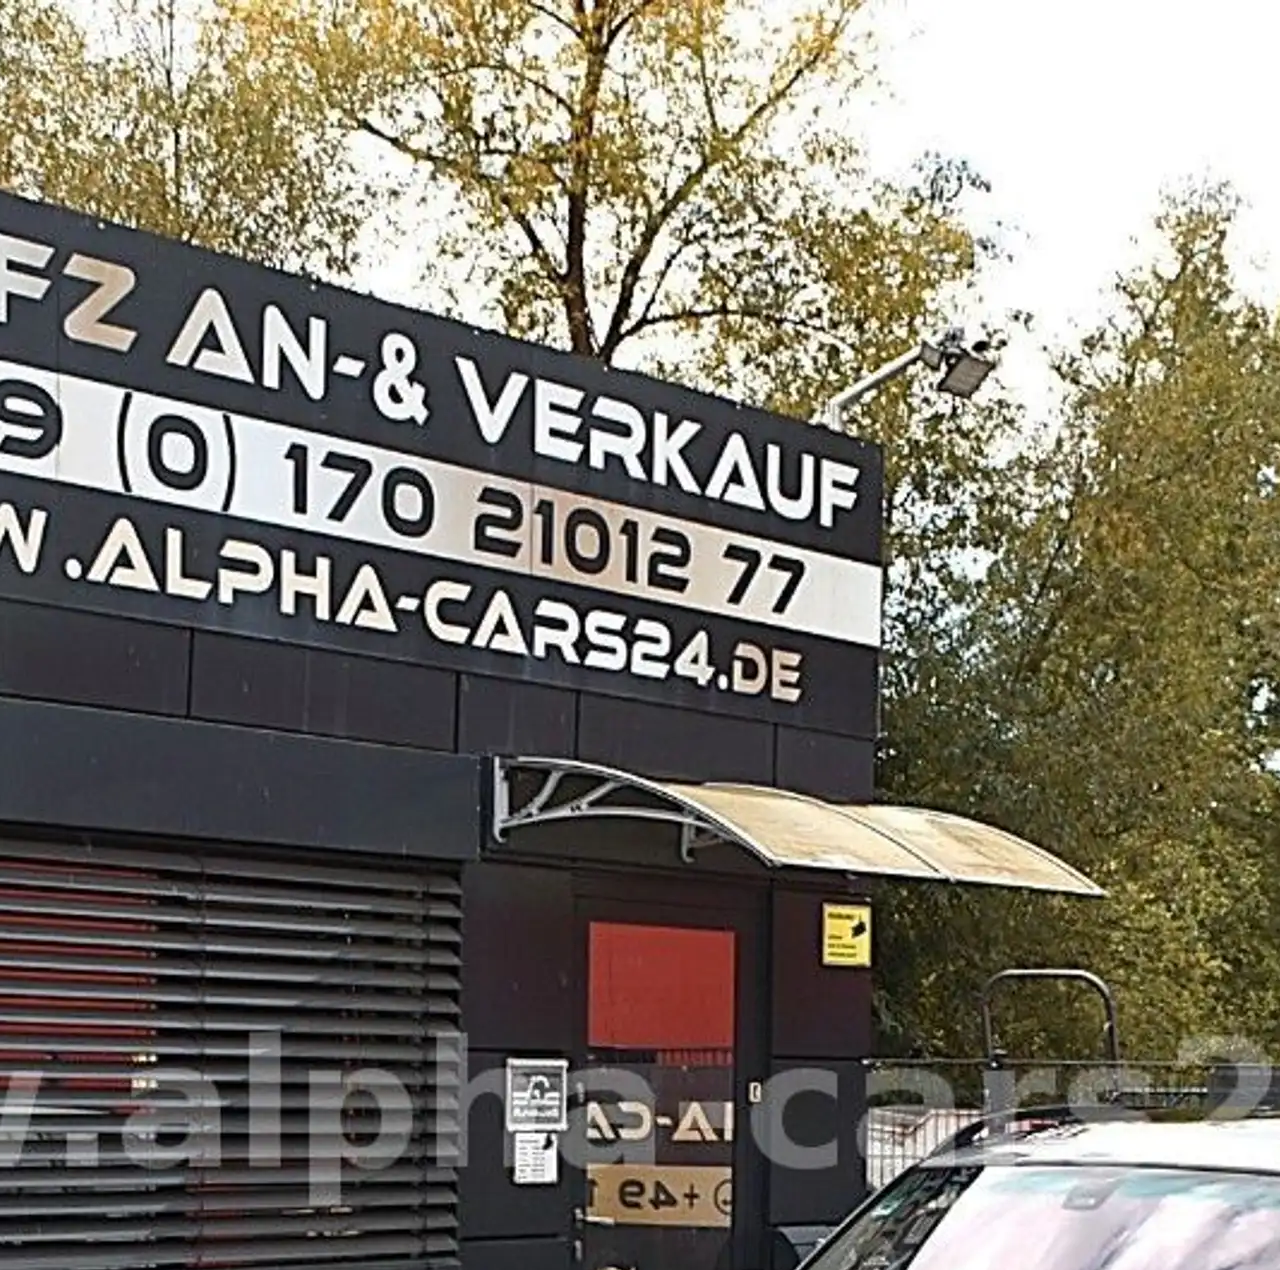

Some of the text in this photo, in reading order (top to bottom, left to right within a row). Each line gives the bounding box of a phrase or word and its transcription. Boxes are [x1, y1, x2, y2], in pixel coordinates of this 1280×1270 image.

[116, 388, 240, 513] (0)
[283, 441, 437, 540] 170
[473, 484, 693, 596] 21012
[720, 545, 808, 616] 77
[453, 356, 860, 529] VERKAUF
